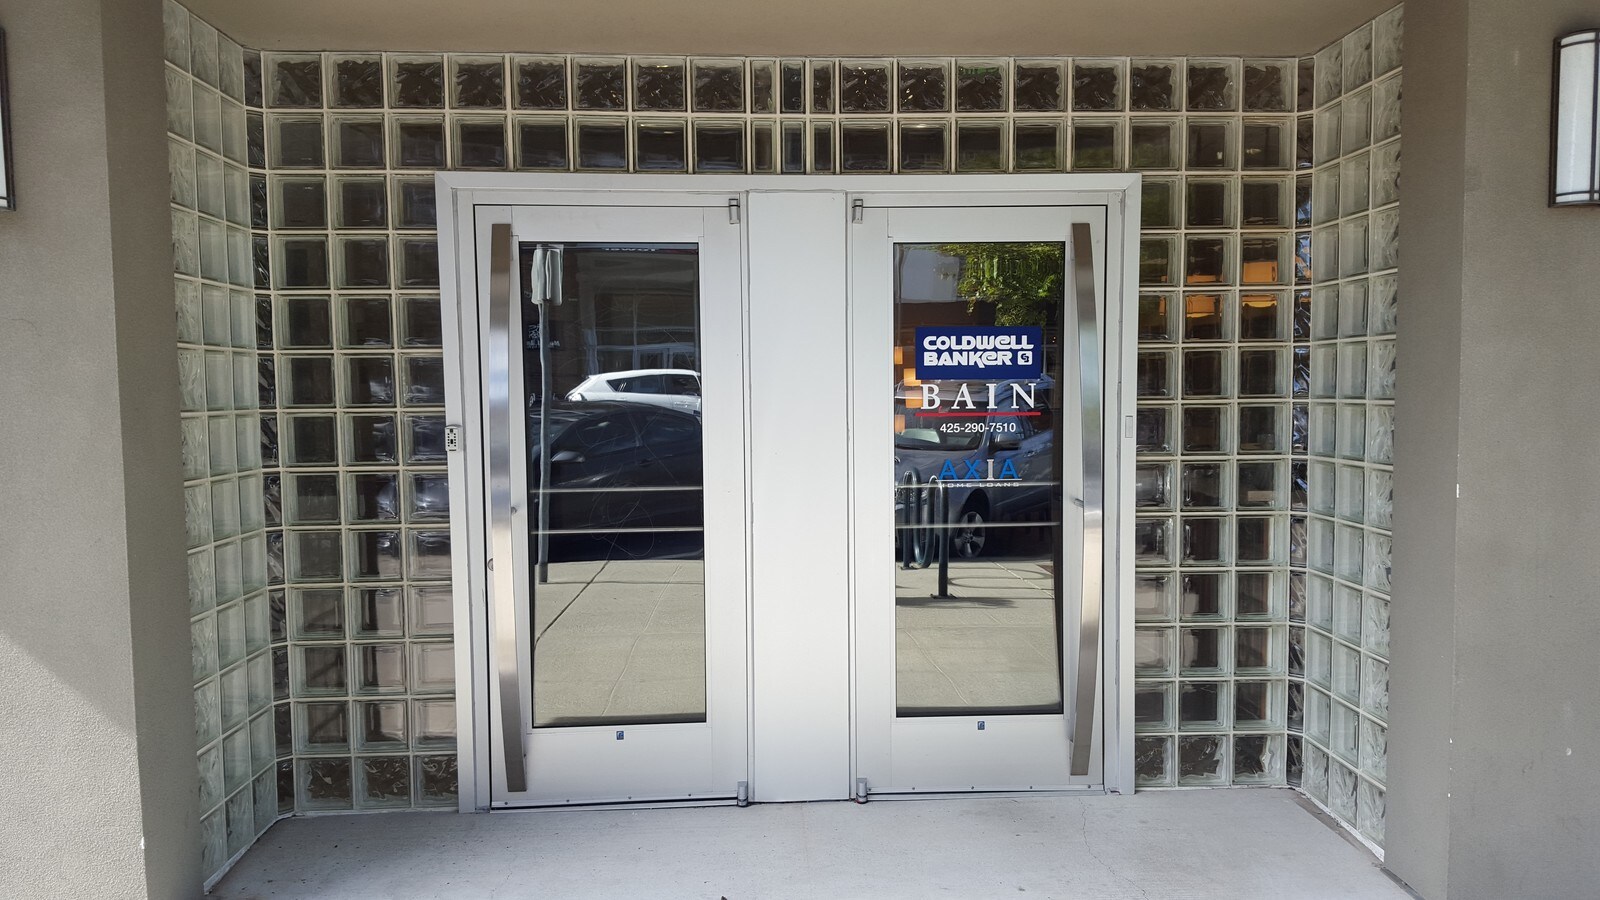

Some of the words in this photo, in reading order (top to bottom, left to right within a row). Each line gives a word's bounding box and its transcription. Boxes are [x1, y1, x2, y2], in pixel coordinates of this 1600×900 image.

[920, 383, 1037, 410] BAIN
[940, 423, 1016, 433] 425-290-7510
[940, 459, 1019, 480] AXIA
